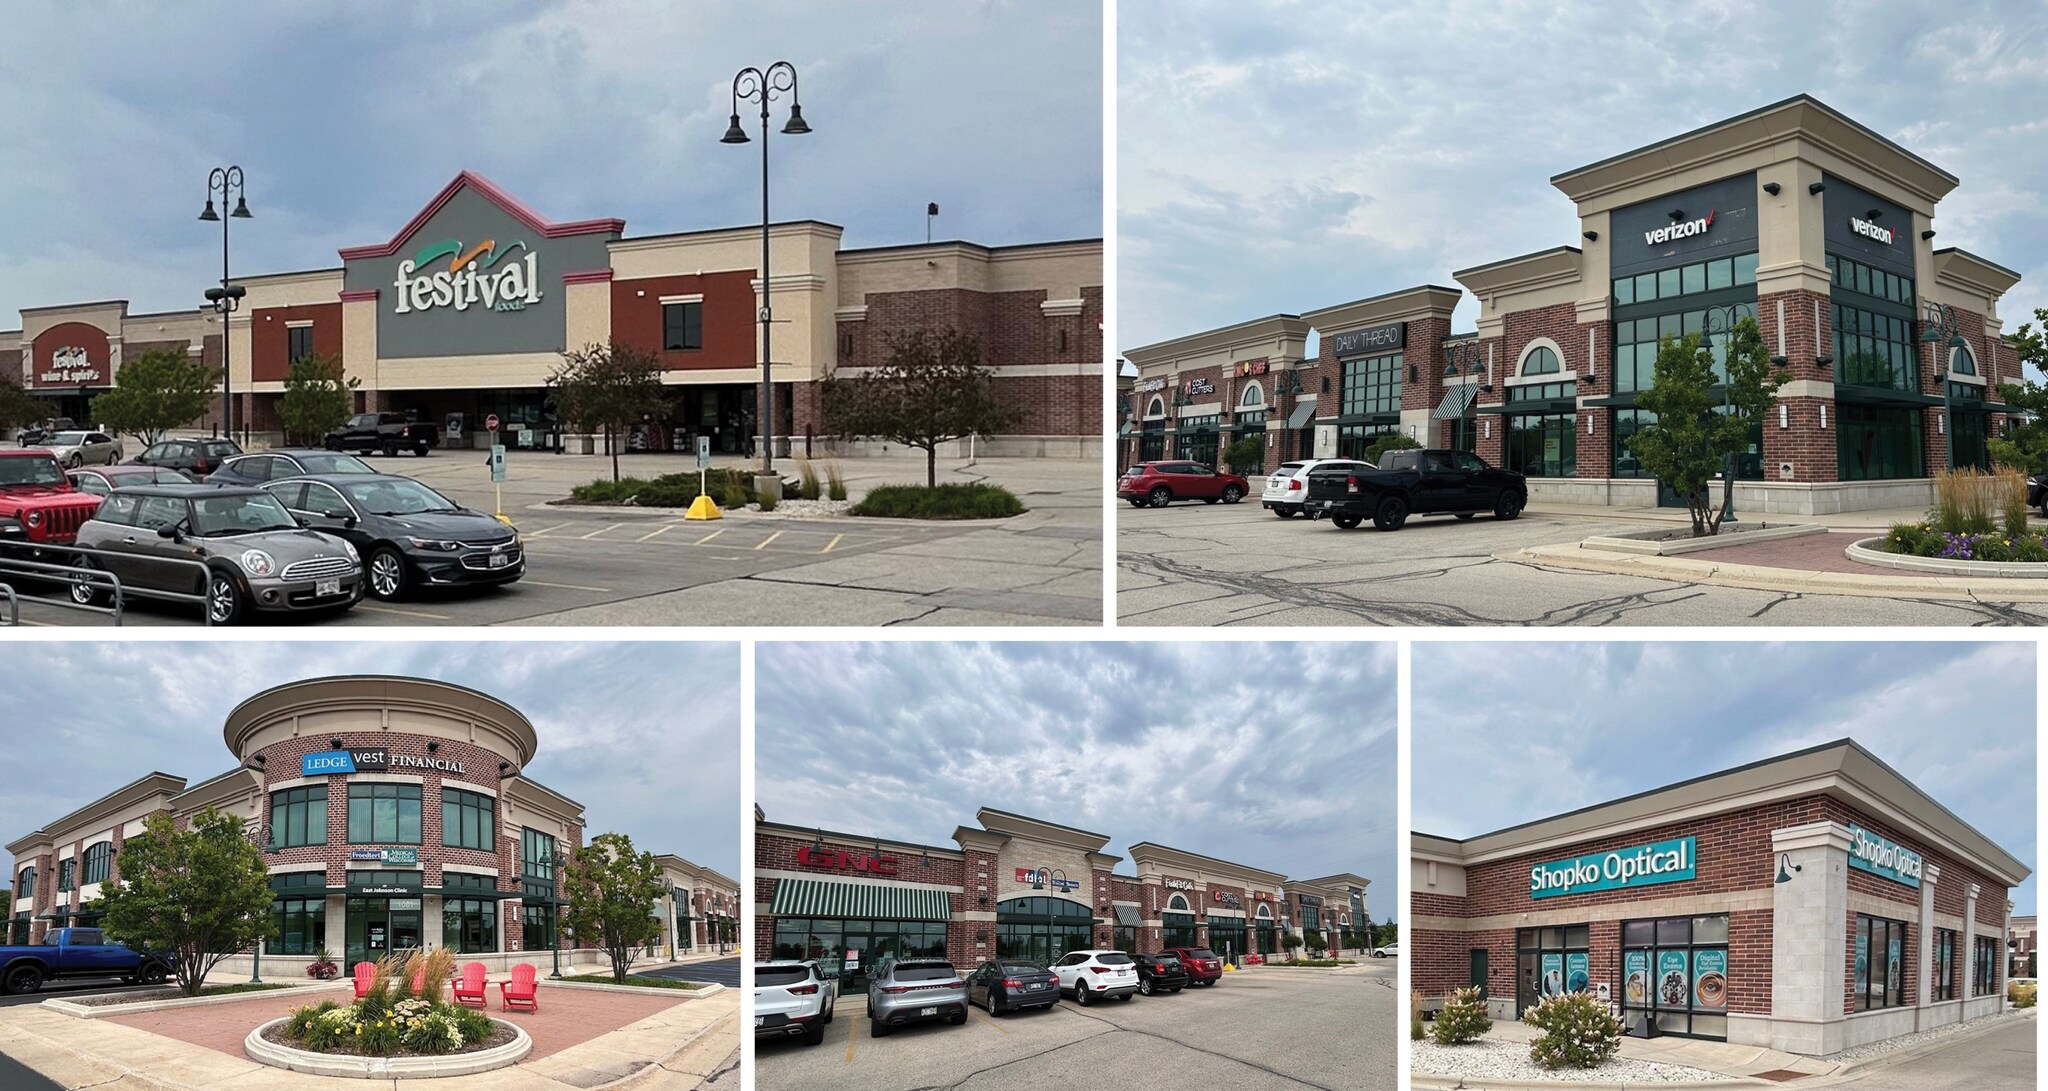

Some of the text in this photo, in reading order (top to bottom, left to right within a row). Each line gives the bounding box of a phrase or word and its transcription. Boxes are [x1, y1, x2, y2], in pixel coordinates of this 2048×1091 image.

[1645, 219, 1707, 245] verizon
[1851, 217, 1892, 244] verizon
[393, 251, 541, 313] festival
[1336, 327, 1397, 351] DAILY THREAD
[41, 370, 61, 381] wine
[62, 370, 70, 381] &
[1192, 379, 1206, 387] COST
[1192, 385, 1213, 395] CUTTERS
[307, 751, 465, 773] LEDGE vest FINANCIAL
[797, 847, 897, 875] GNC
[1531, 840, 1688, 891] Shopko Optical
[1852, 829, 1922, 878] Shopko Optical
